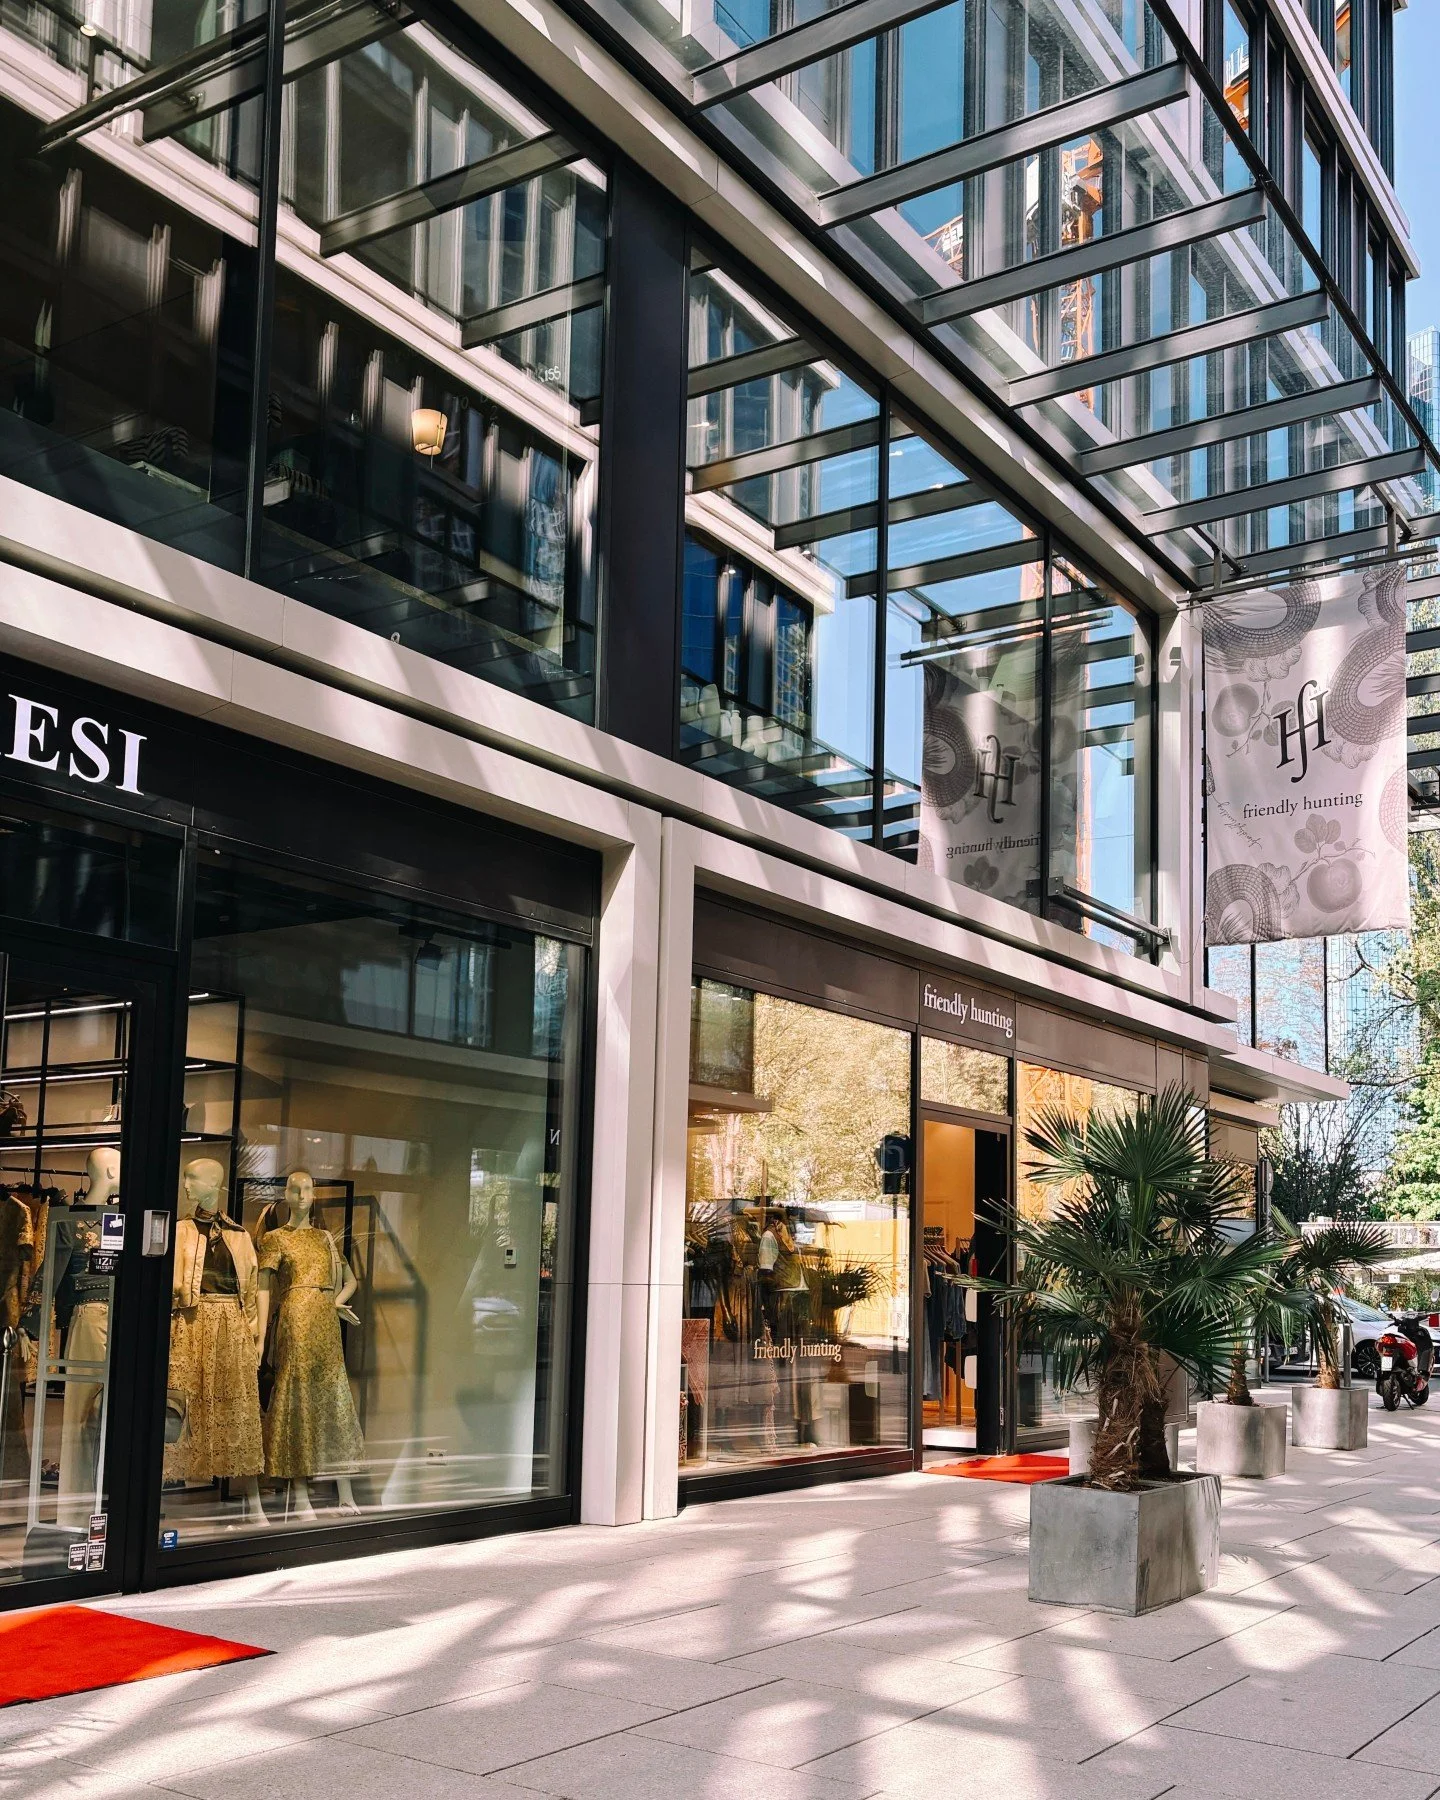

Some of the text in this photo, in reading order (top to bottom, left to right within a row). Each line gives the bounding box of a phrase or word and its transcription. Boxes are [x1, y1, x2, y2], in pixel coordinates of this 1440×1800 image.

[0, 694, 147, 795] ESI
[1243, 792, 1364, 818] friendly hunting
[923, 984, 1013, 1038] friendly hunting
[753, 1338, 842, 1363] friendly hunting
